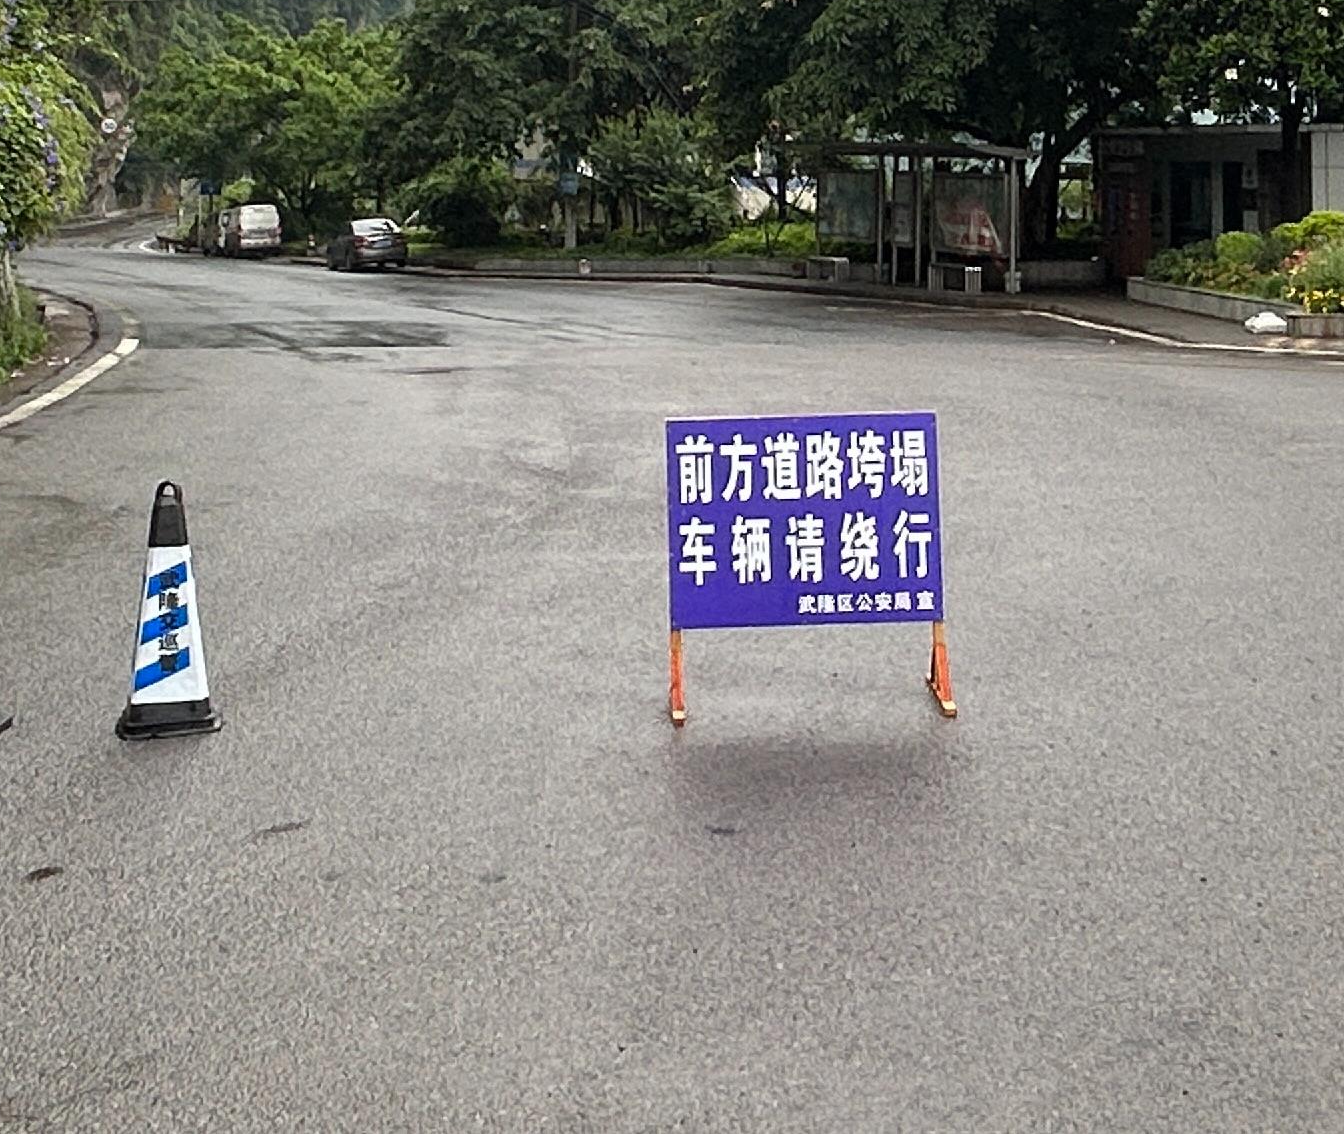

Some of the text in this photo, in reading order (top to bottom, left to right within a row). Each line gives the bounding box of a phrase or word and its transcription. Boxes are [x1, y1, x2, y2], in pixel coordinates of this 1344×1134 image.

[674, 429, 929, 504] 前方道路垮塌
[678, 510, 932, 586] 车辆请绕行
